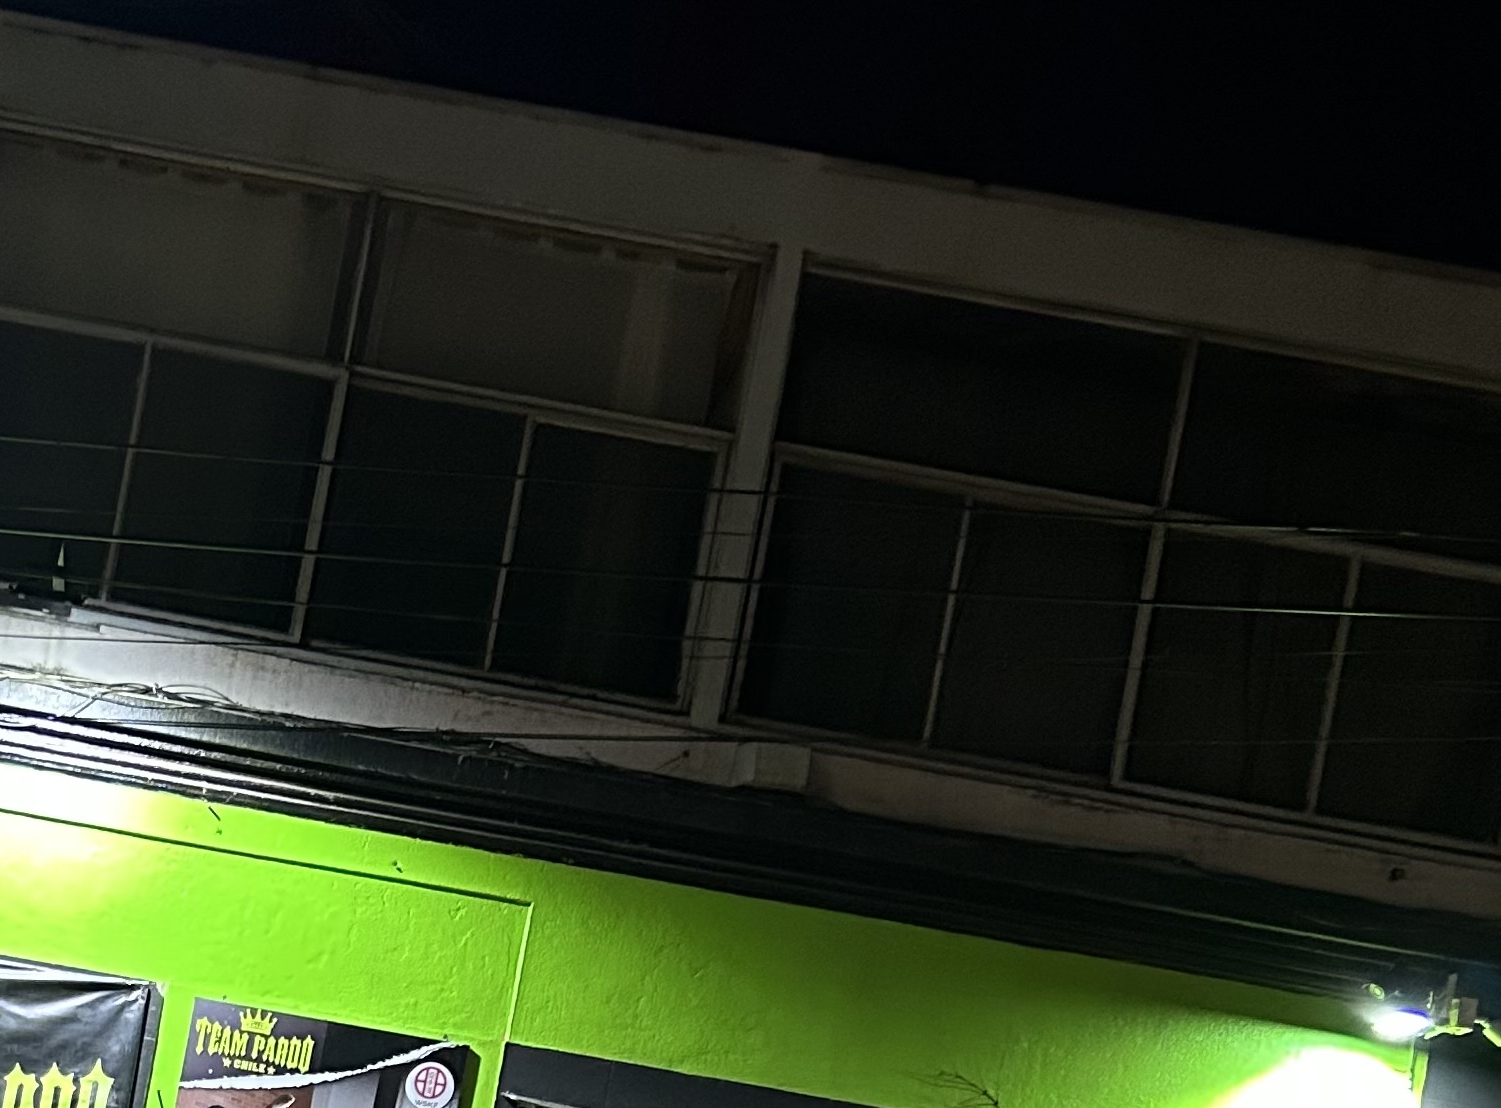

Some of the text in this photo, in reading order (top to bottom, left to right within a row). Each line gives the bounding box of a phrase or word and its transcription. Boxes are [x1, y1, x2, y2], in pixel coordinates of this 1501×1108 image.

[195, 1016, 315, 1074] TEAM PARDO
[233, 1058, 267, 1074] CHILE
